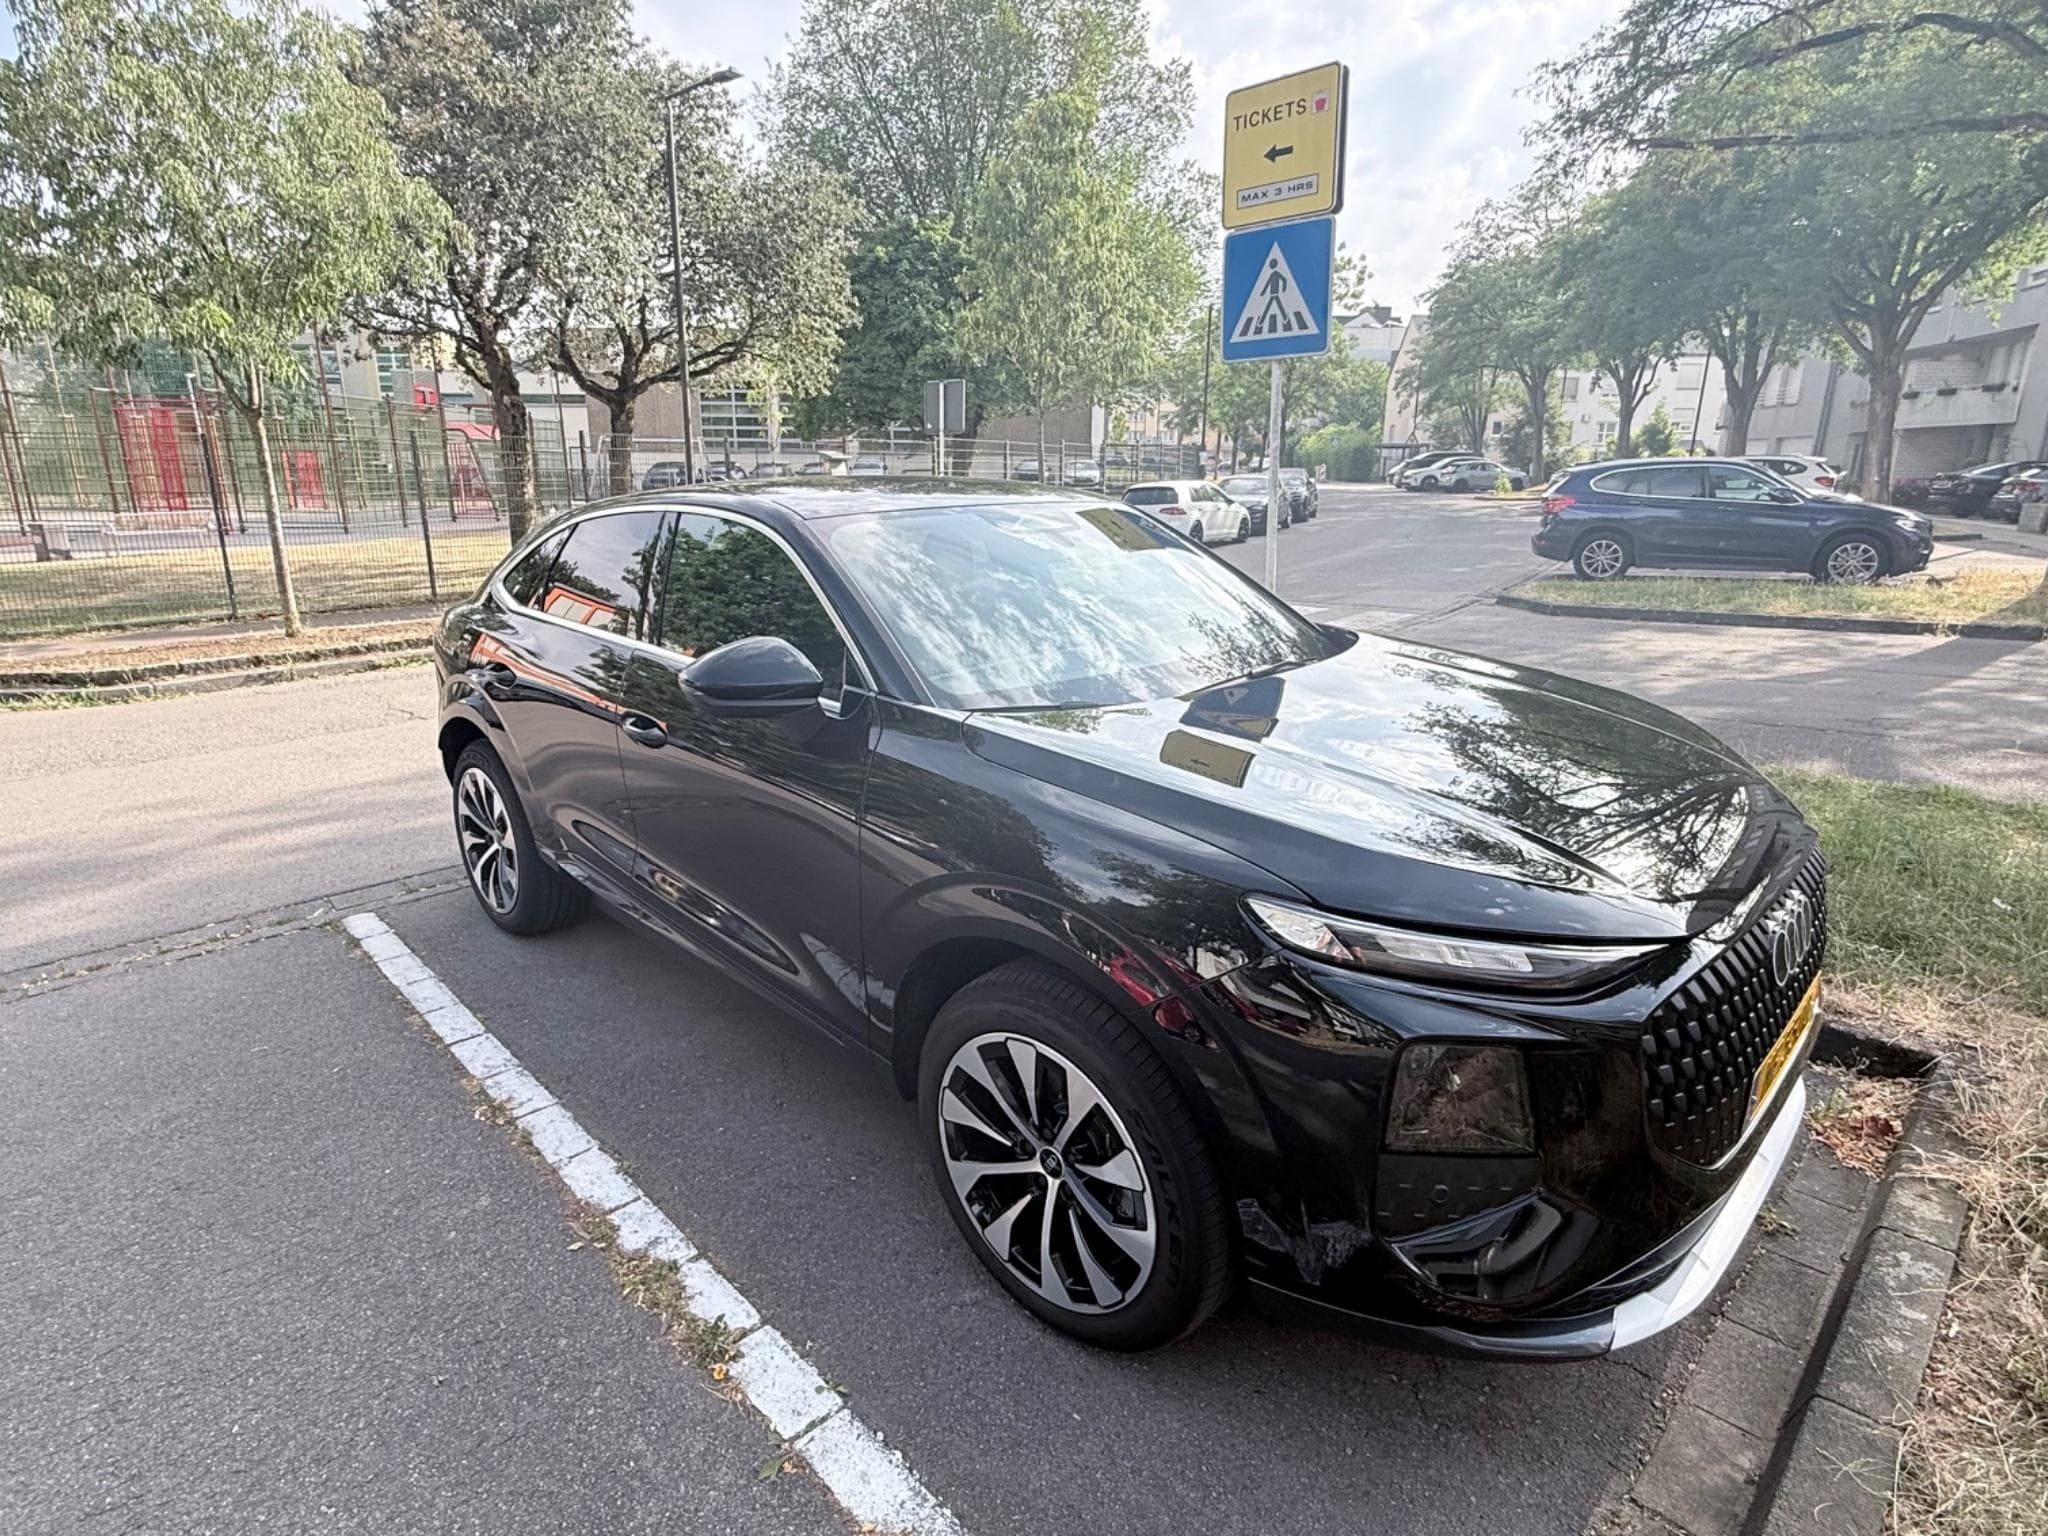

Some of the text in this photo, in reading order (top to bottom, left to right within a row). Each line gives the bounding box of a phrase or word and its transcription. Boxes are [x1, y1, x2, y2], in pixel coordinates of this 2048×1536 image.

[1233, 98, 1307, 131] TICKETS
[1241, 181, 1313, 203] MAX 3 HRS
